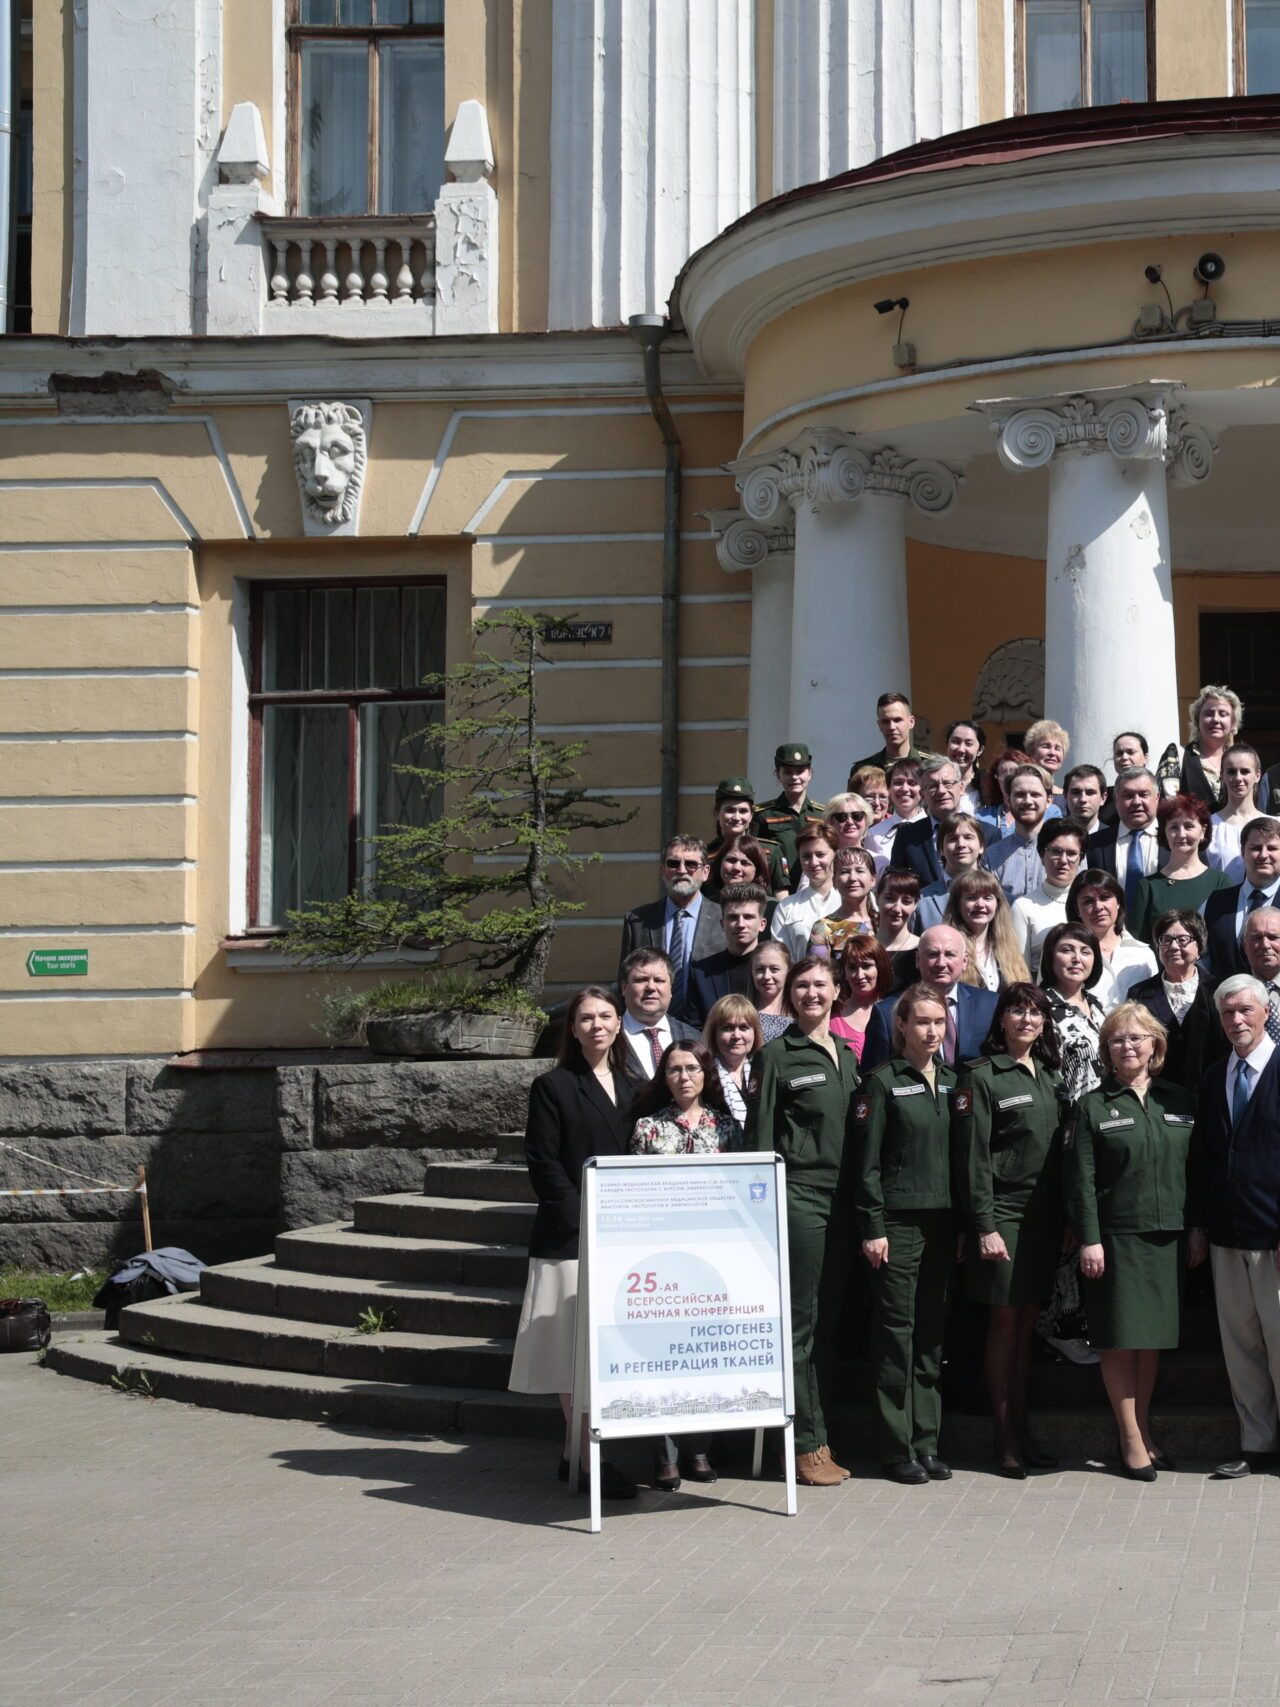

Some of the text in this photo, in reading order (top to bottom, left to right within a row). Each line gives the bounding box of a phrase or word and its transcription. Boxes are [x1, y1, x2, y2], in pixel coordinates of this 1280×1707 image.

[627, 1293, 728, 1306] ВСЕРОССИЙСКАЯ
[627, 1304, 765, 1319] НАУЧНАЯ КОНФЕРЕНЦИЯ
[690, 1322, 773, 1336] ГИСТОГЕНЕЗ
[669, 1339, 774, 1354] РЕАКТИВНОСТЬ
[610, 1352, 774, 1374] И РЕГЕНЕРАЦИЯ ТКАНЕЙ
